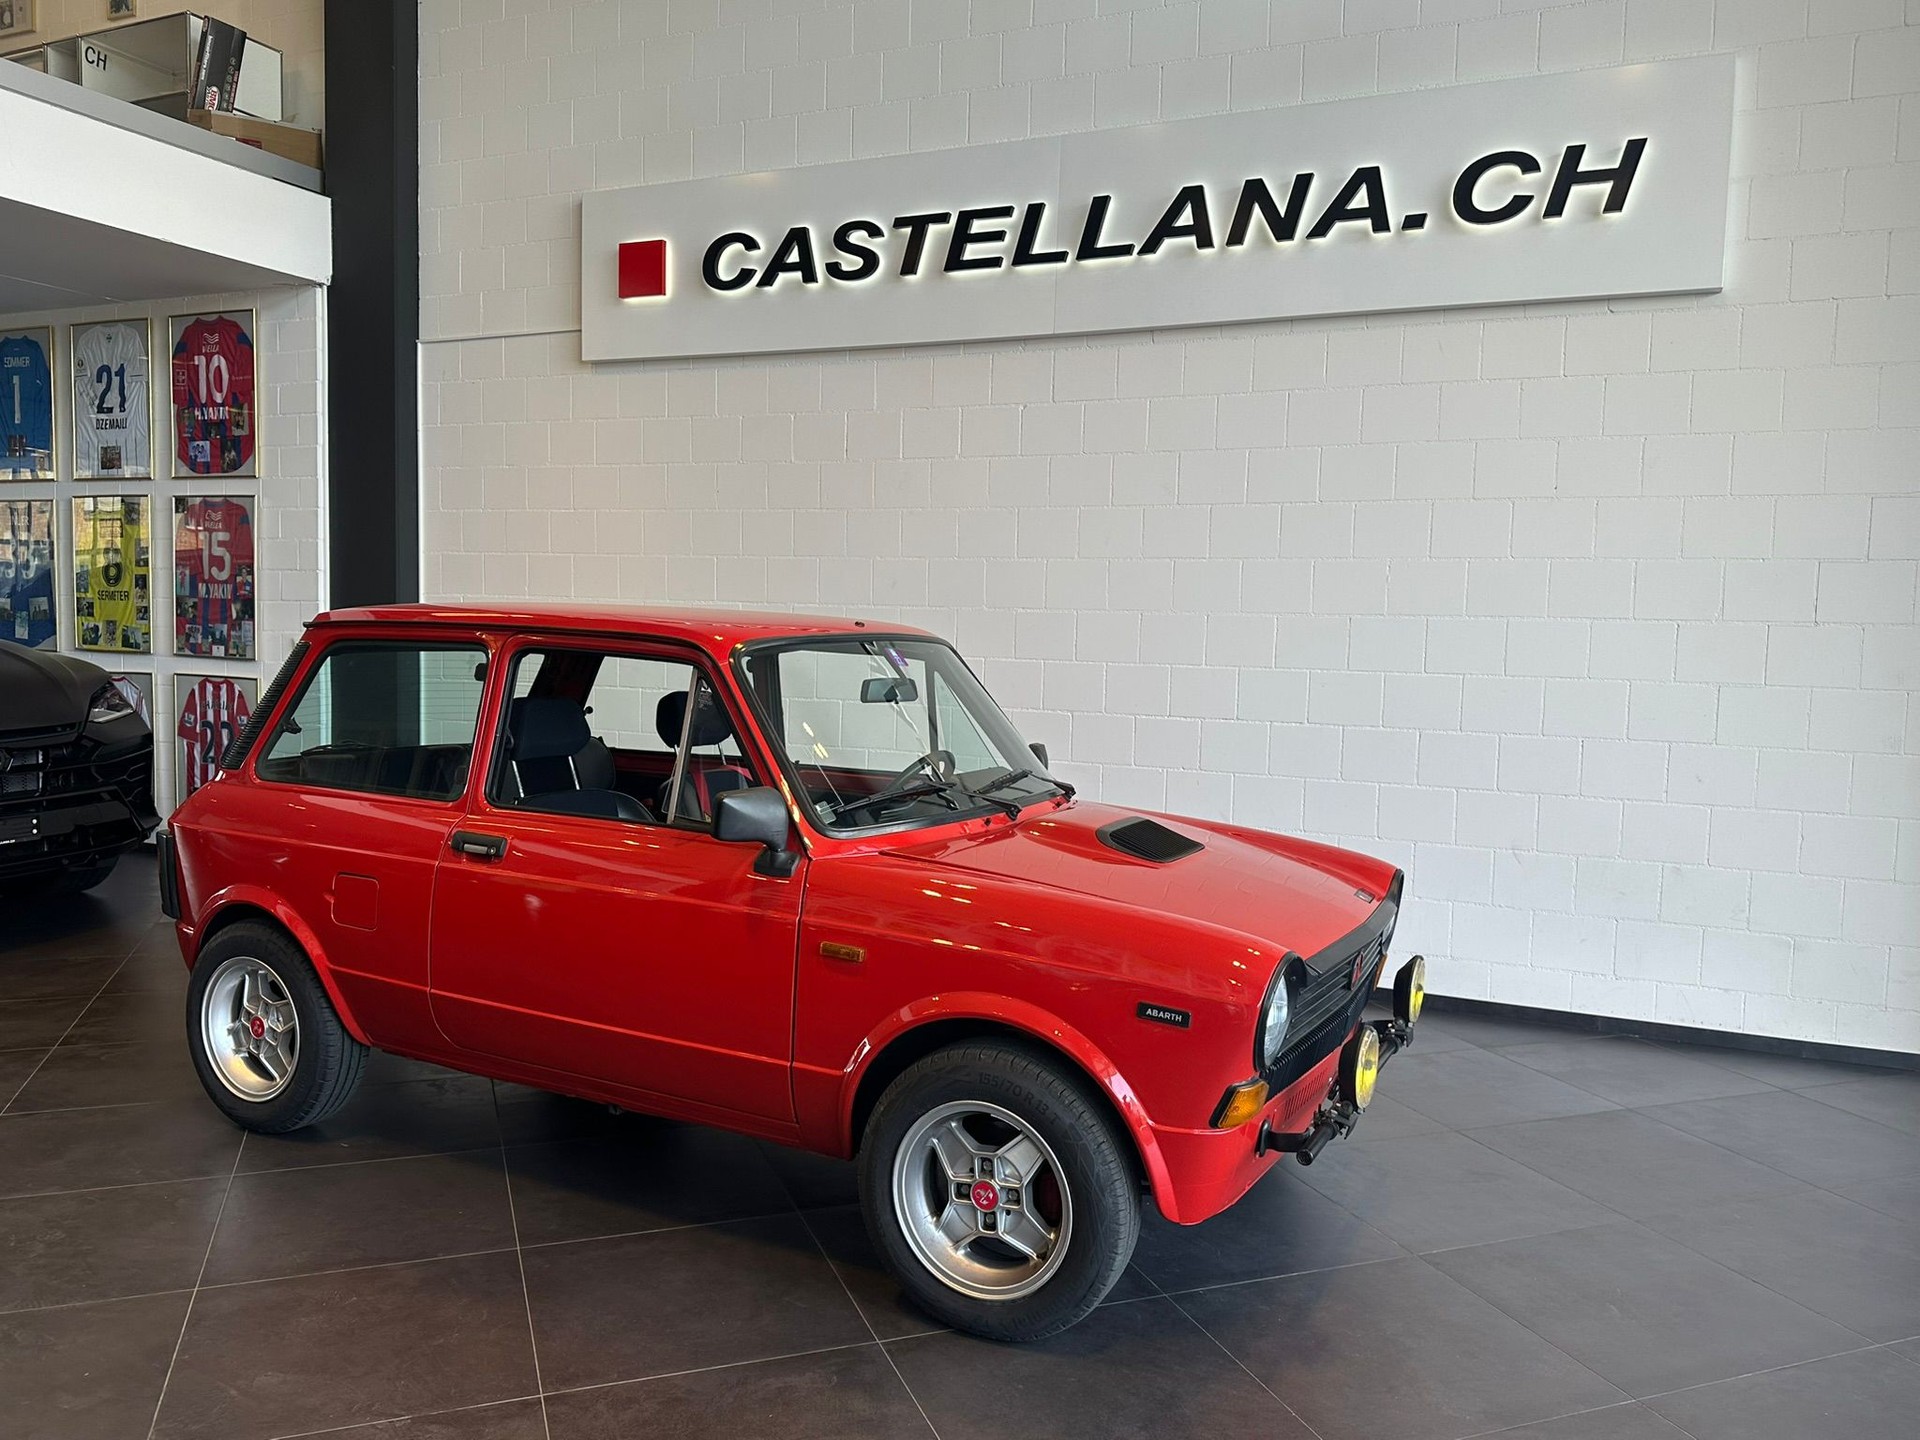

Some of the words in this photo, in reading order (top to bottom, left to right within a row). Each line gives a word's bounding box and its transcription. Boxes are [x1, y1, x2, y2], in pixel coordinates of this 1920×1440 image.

[85, 46, 107, 72] CH
[702, 137, 1648, 292] CASTELLANA.CH
[4, 356, 31, 368] SOMMER
[194, 354, 229, 404] 10
[13, 375, 21, 424] 1
[96, 363, 127, 414] 21
[96, 418, 128, 430] DZEMAILI
[198, 531, 232, 581] 15
[97, 589, 130, 602] SERMETER
[1146, 1008, 1182, 1022] ABARTH
[978, 1071, 1022, 1097] 155/70
[1023, 1092, 1035, 1106] R
